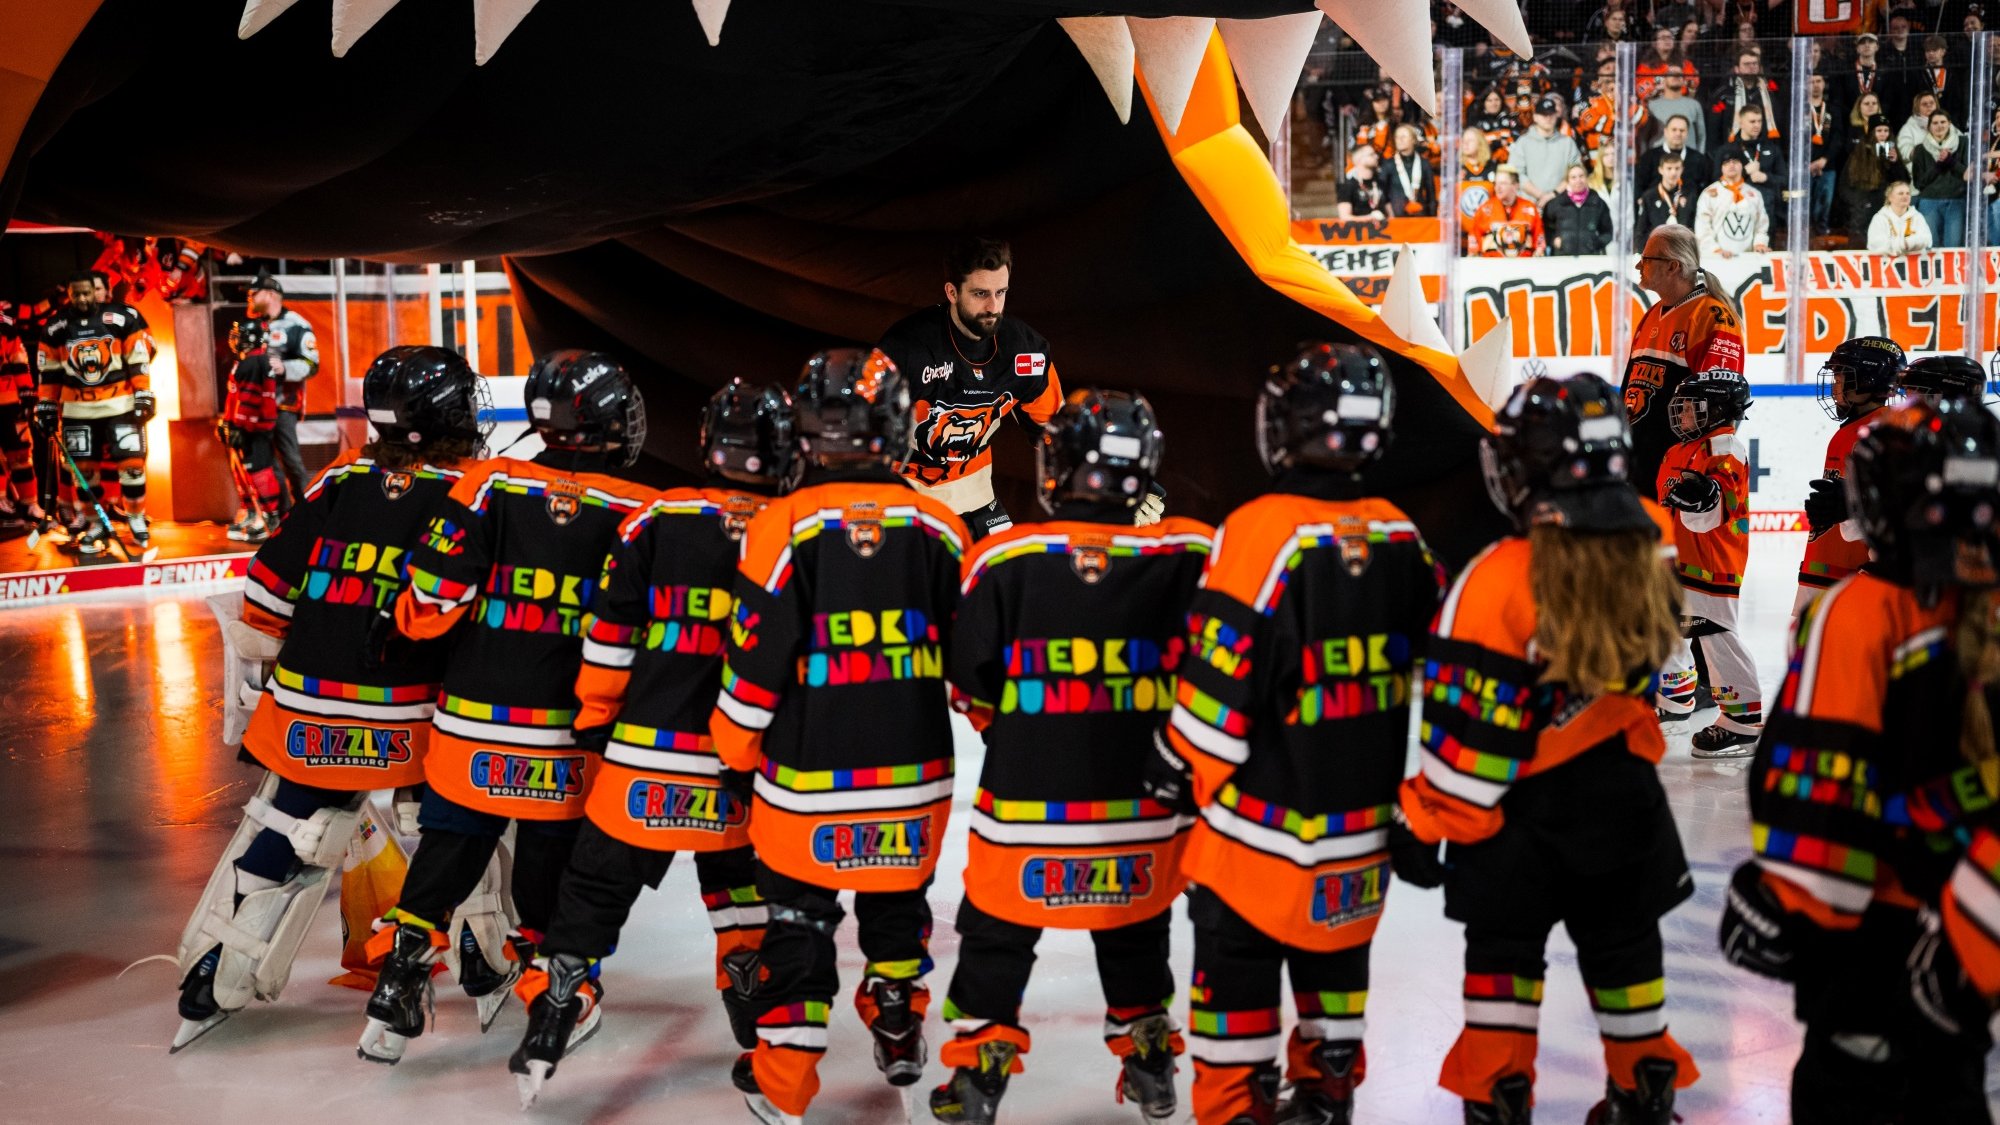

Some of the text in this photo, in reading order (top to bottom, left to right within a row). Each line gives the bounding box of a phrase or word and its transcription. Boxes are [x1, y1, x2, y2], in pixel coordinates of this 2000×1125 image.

[289, 723, 409, 760] GRIZZLYS
[309, 757, 386, 767] WOLFSBURG
[472, 752, 582, 791] GRIZZLYS
[491, 787, 563, 800] WOLFSBURG
[813, 819, 931, 863] GRIZZLYS
[1022, 855, 1152, 899] GRIZZLYS
